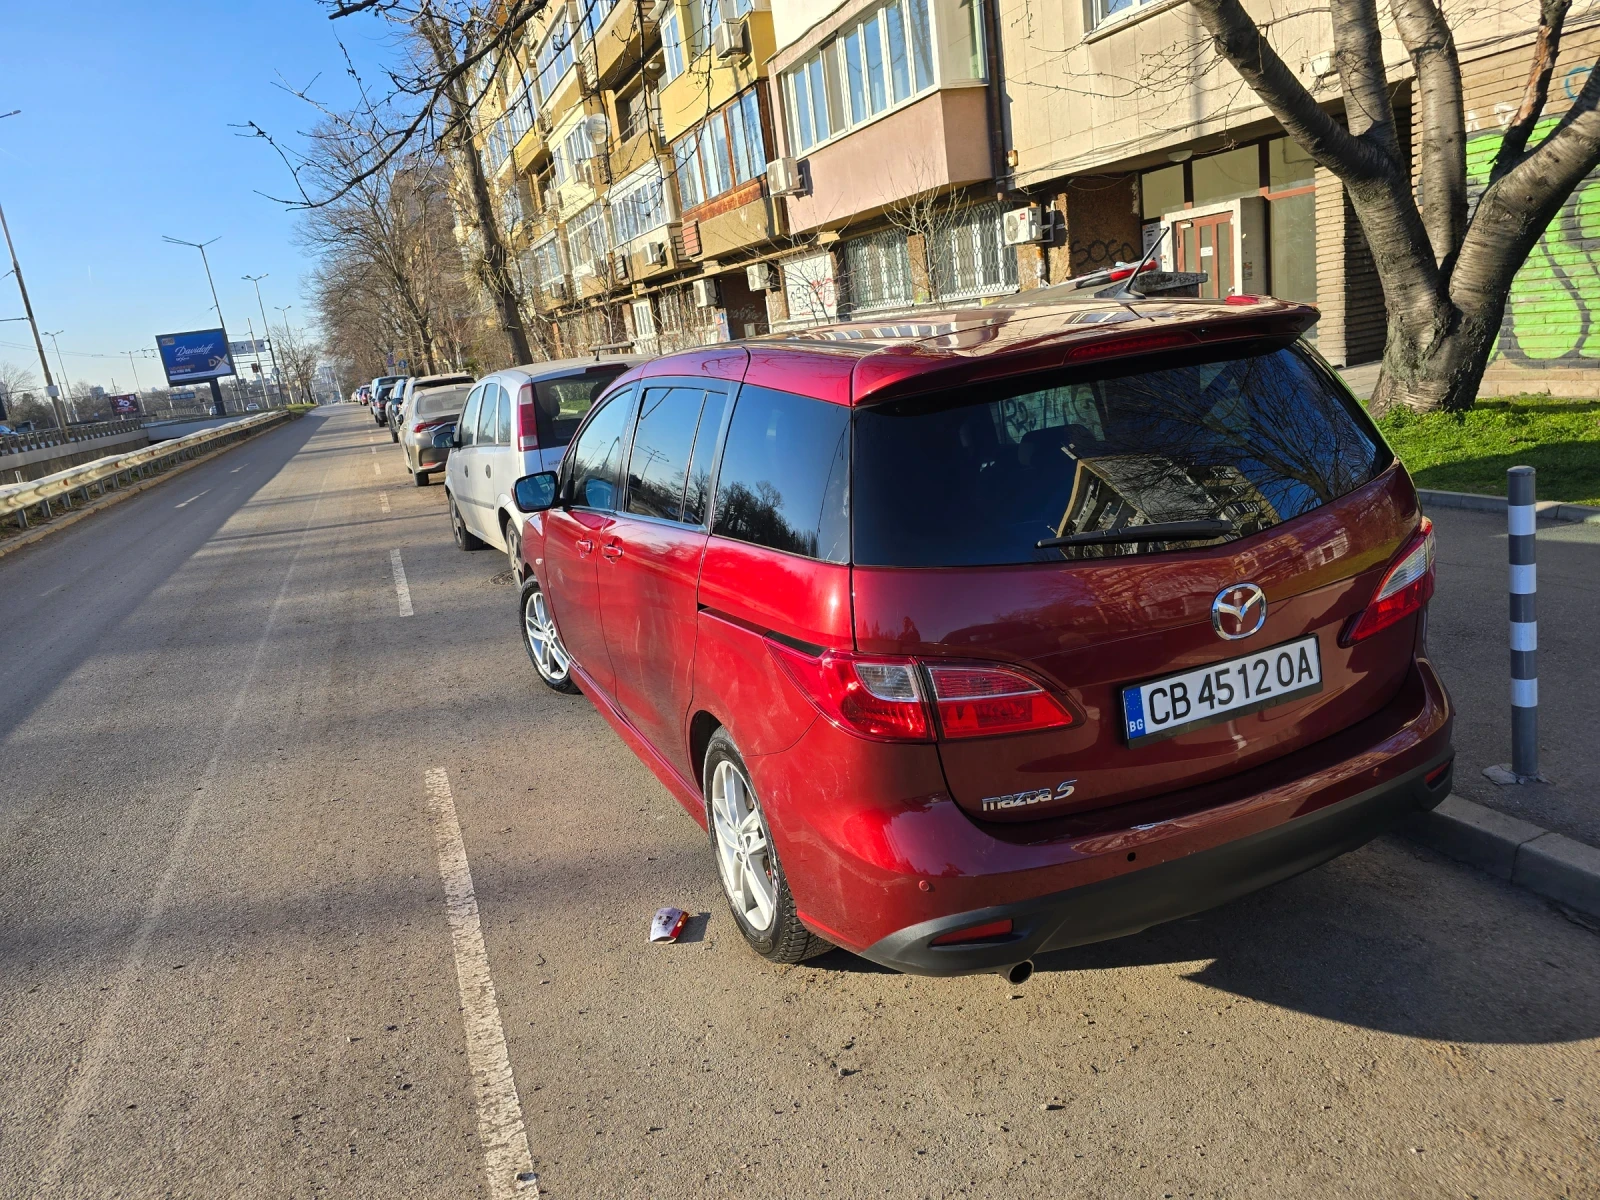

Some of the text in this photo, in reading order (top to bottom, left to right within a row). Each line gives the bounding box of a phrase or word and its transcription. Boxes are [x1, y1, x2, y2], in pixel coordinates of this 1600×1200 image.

[175, 343, 214, 356] Davidoff
[1148, 647, 1314, 725] CB 4512 OA
[1129, 718, 1144, 733] BG
[1054, 779, 1078, 800] 5
